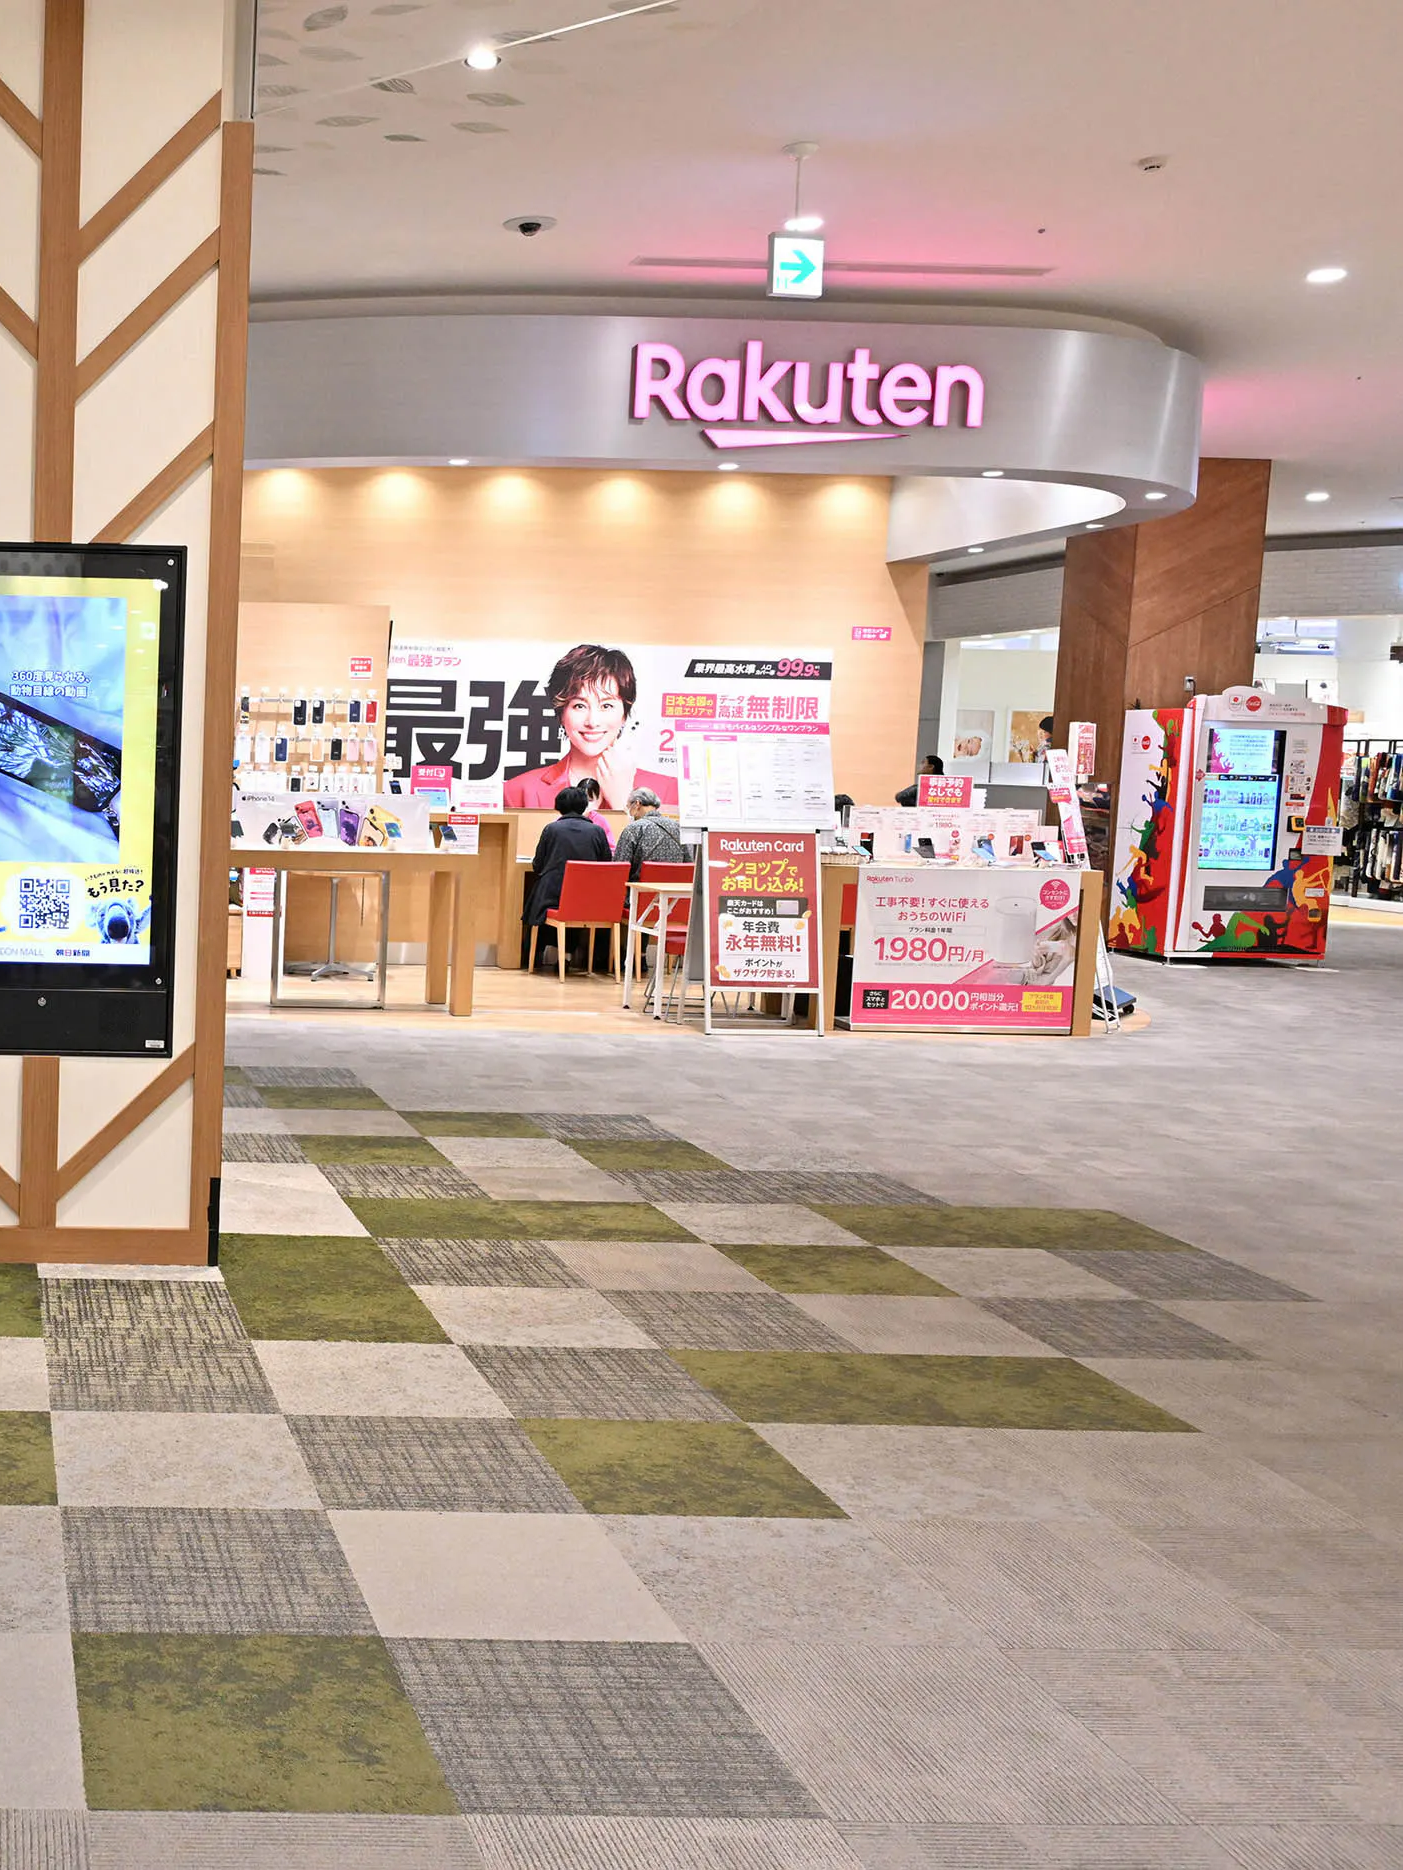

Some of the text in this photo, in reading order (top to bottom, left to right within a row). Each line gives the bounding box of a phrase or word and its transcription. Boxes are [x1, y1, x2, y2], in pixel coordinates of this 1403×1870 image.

[632, 340, 985, 428] Rakuten
[693, 663, 756, 674] 業界最高水準
[10, 684, 87, 697] 動物目線の動画
[666, 695, 714, 706] 日本全国の
[719, 694, 745, 704] データ
[718, 705, 744, 719] 高速
[747, 694, 819, 719] 無制限
[928, 787, 963, 797] なしでも
[720, 838, 804, 853] Rakuten Card
[728, 858, 798, 876] ショップで
[721, 876, 804, 893] お申し込み!
[866, 875, 894, 883] Rakuten
[87, 877, 145, 898] もう見た?
[897, 911, 966, 922] おうちのWiFi
[742, 920, 780, 934] 年会費
[725, 934, 801, 952] 永年無料!
[745, 959, 783, 967] ポイントが
[733, 968, 795, 979] ザクザク貯まる!
